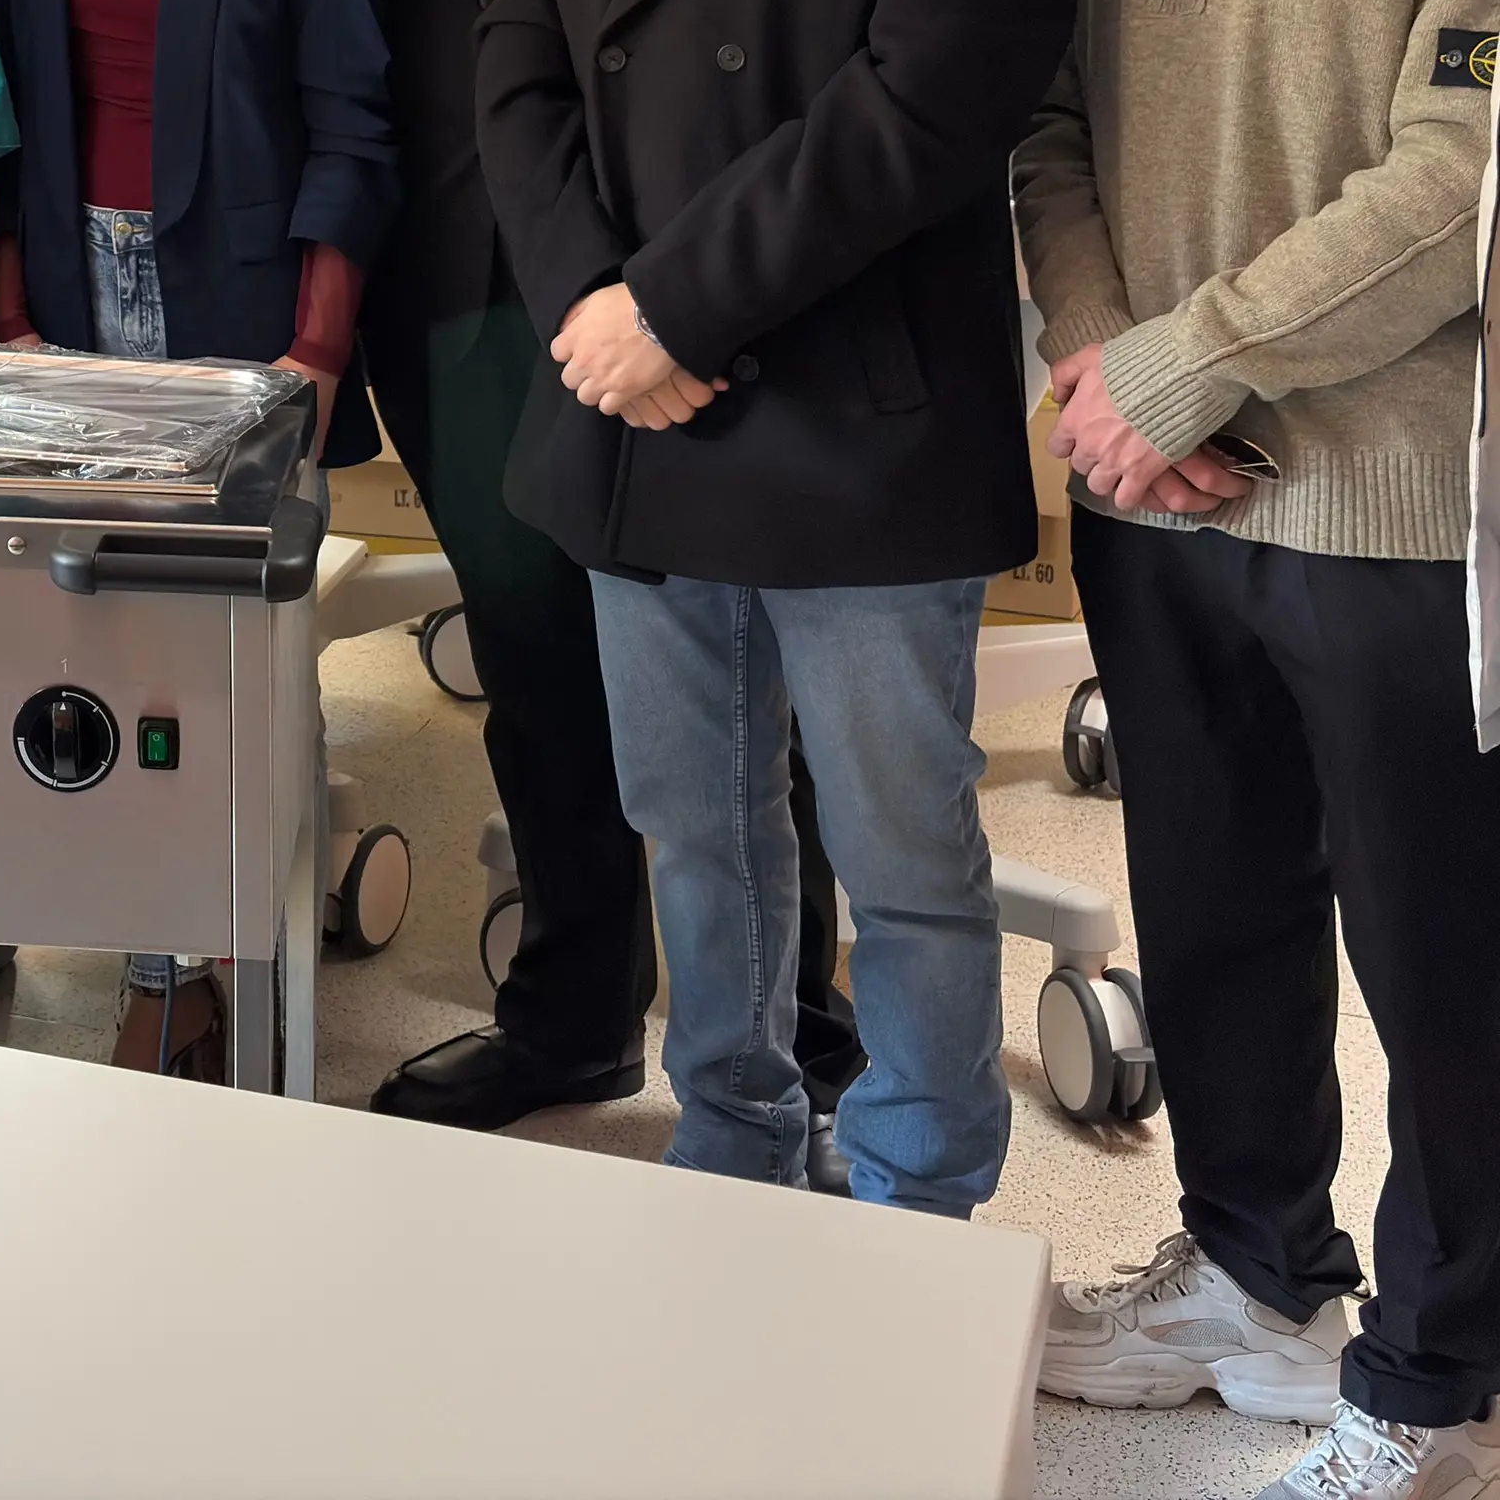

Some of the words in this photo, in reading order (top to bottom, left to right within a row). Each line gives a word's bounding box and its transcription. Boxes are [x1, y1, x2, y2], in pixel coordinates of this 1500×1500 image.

[394, 489, 410, 508] LT.
[1035, 563, 1055, 585] 60
[61, 657, 68, 674] 1
